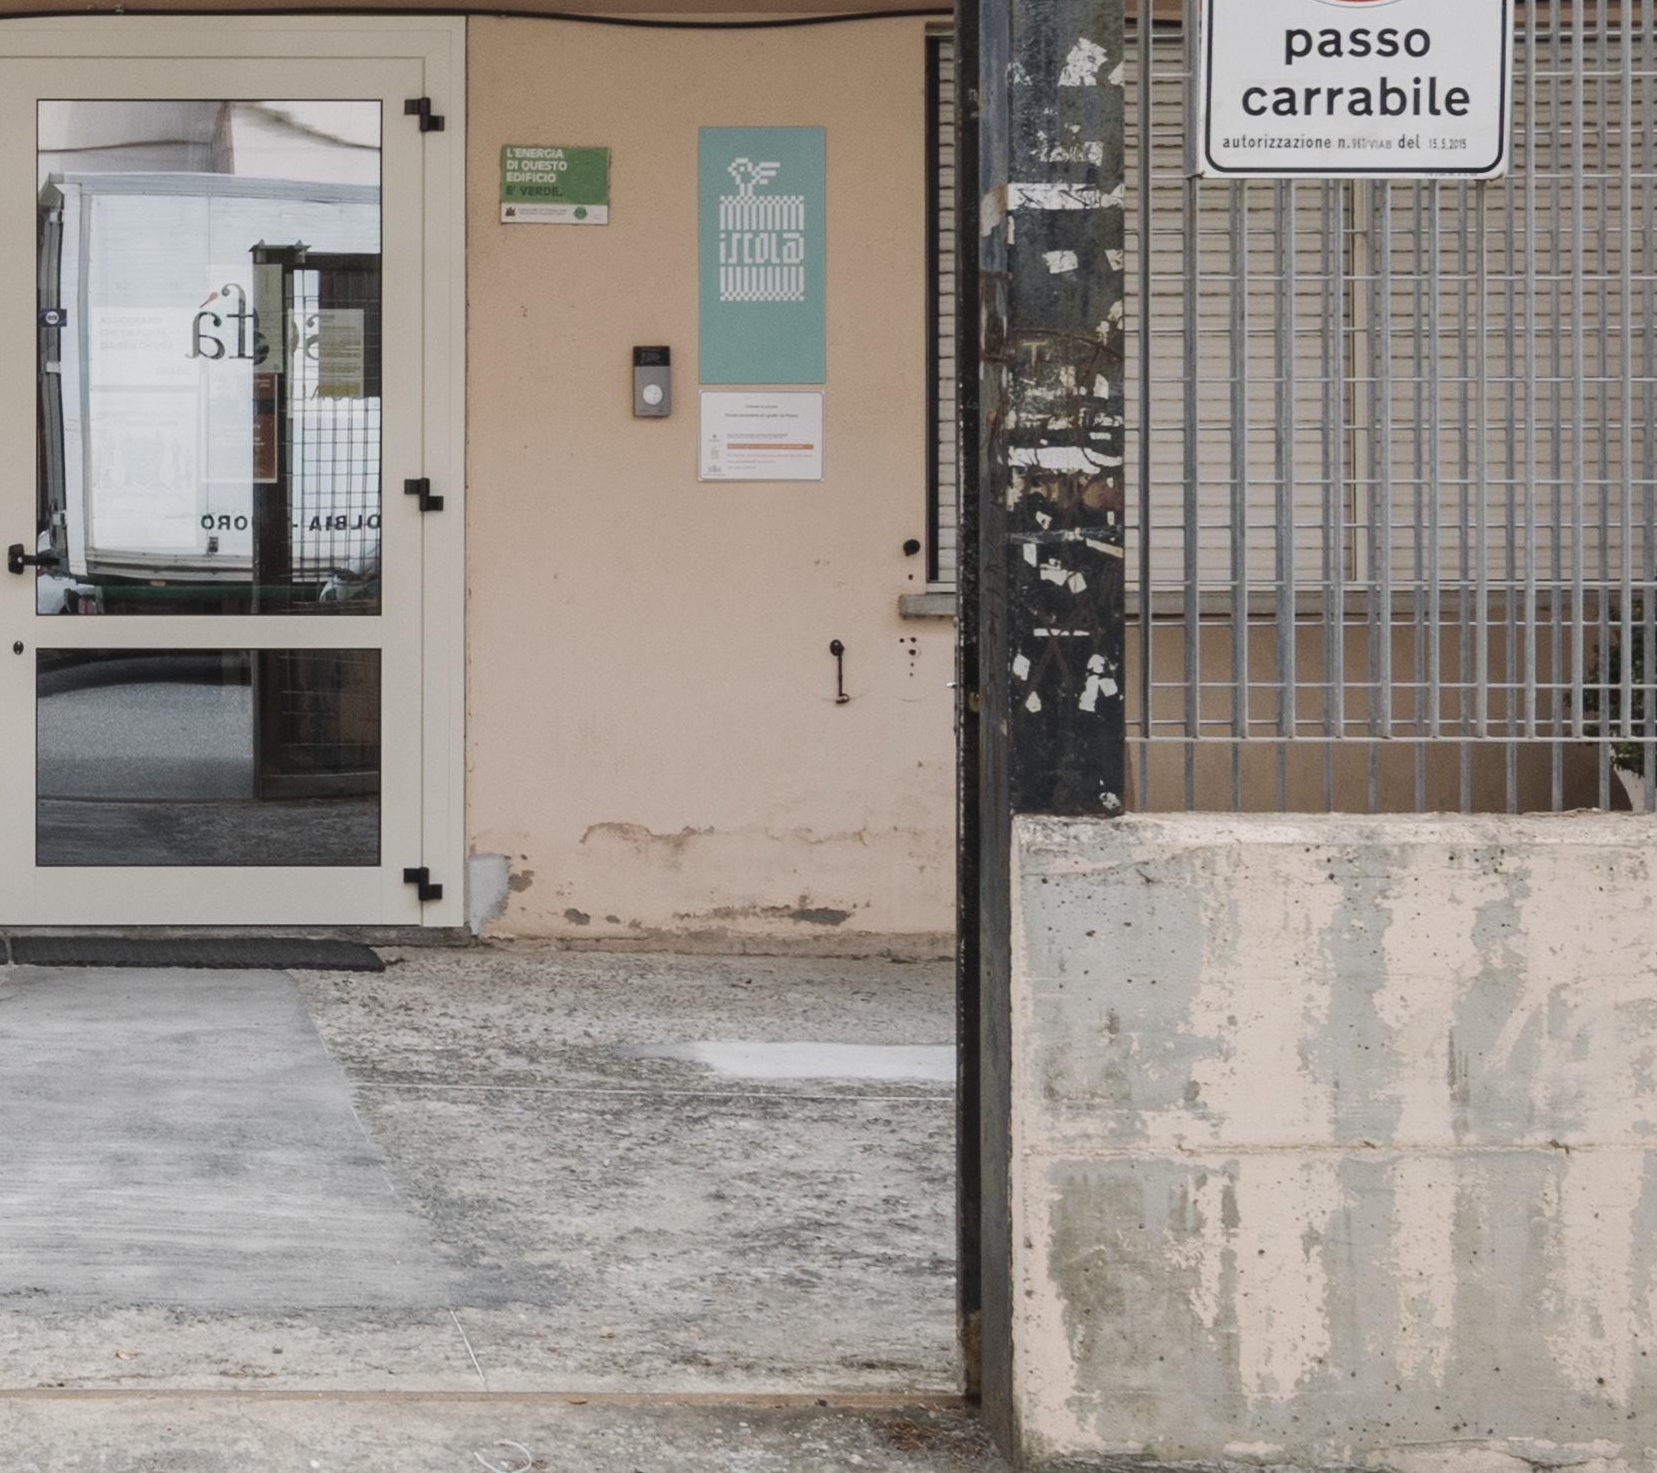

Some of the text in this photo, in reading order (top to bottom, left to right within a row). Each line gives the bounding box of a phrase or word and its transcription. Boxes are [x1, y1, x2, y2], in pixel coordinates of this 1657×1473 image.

[1285, 28, 1431, 65] passo
[1242, 76, 1470, 117] carrabile
[1222, 134, 1332, 149] autorizzazione
[1397, 133, 1421, 149] del
[506, 147, 565, 159] L'ENERGIA
[506, 160, 568, 171] DI QUESTO
[506, 172, 556, 183] EDIFICIO
